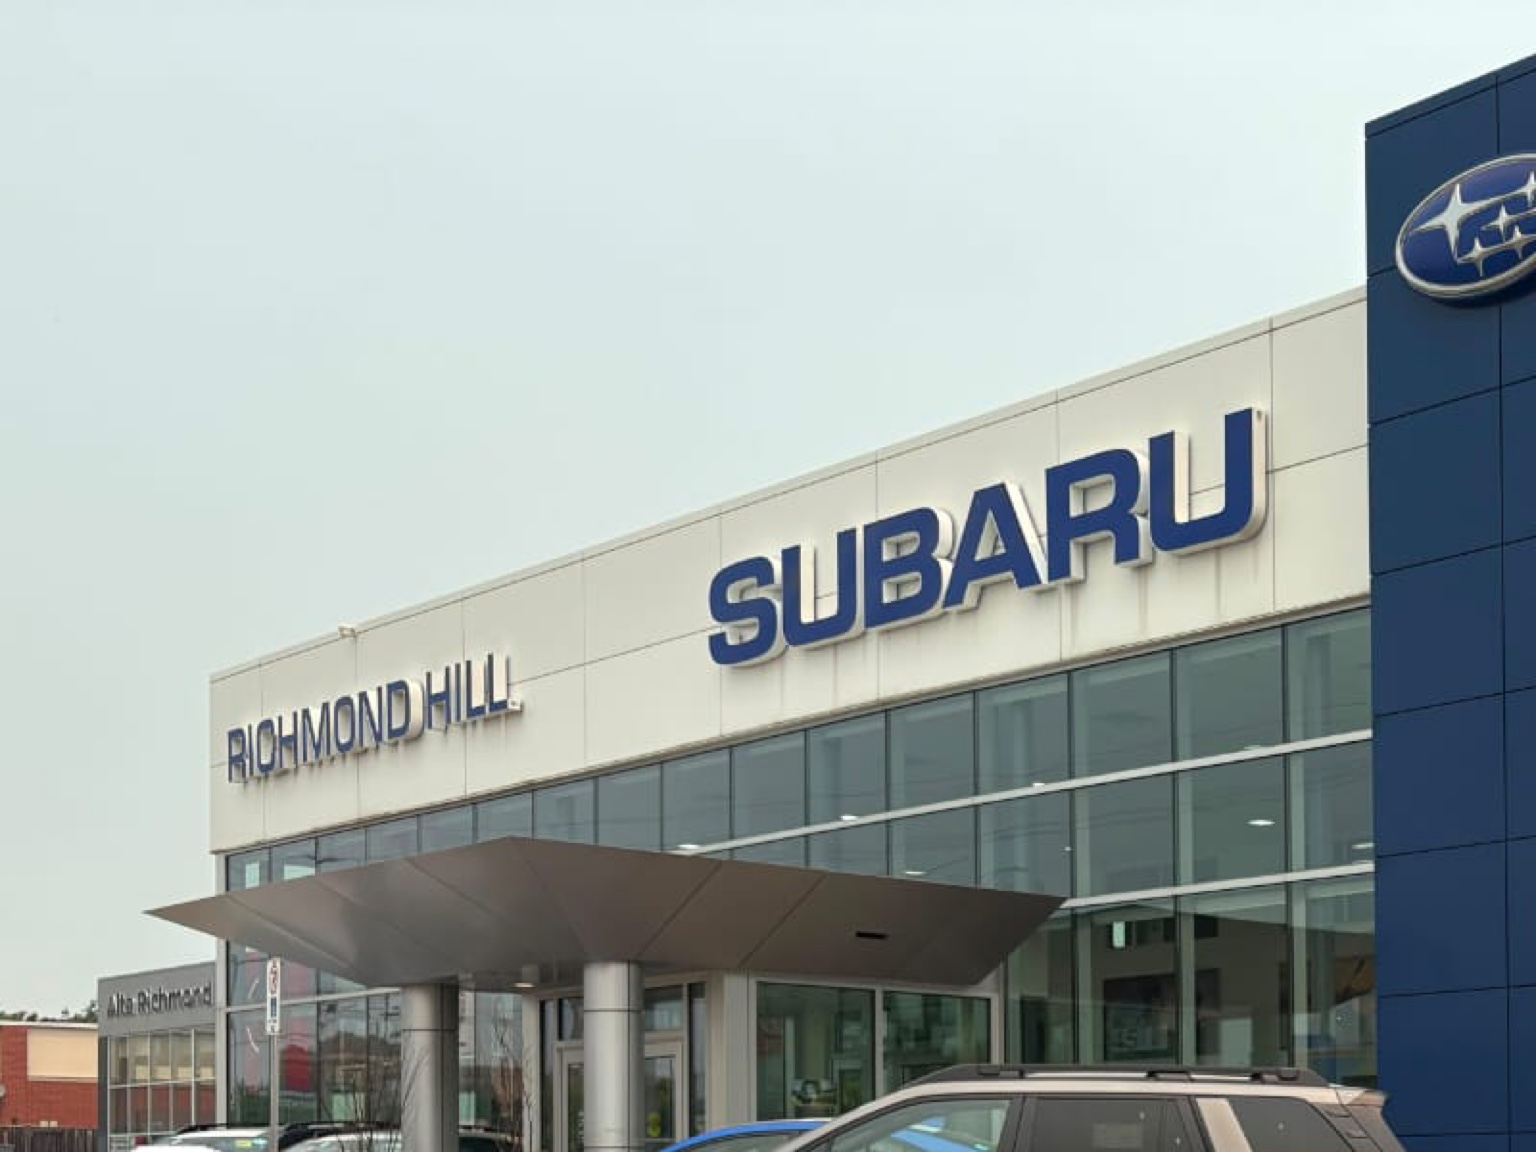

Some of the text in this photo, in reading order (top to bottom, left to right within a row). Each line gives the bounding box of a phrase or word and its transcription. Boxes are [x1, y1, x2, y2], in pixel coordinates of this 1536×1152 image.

[708, 406, 1260, 666] SUBARU
[227, 653, 511, 783] RICHMOND HILL
